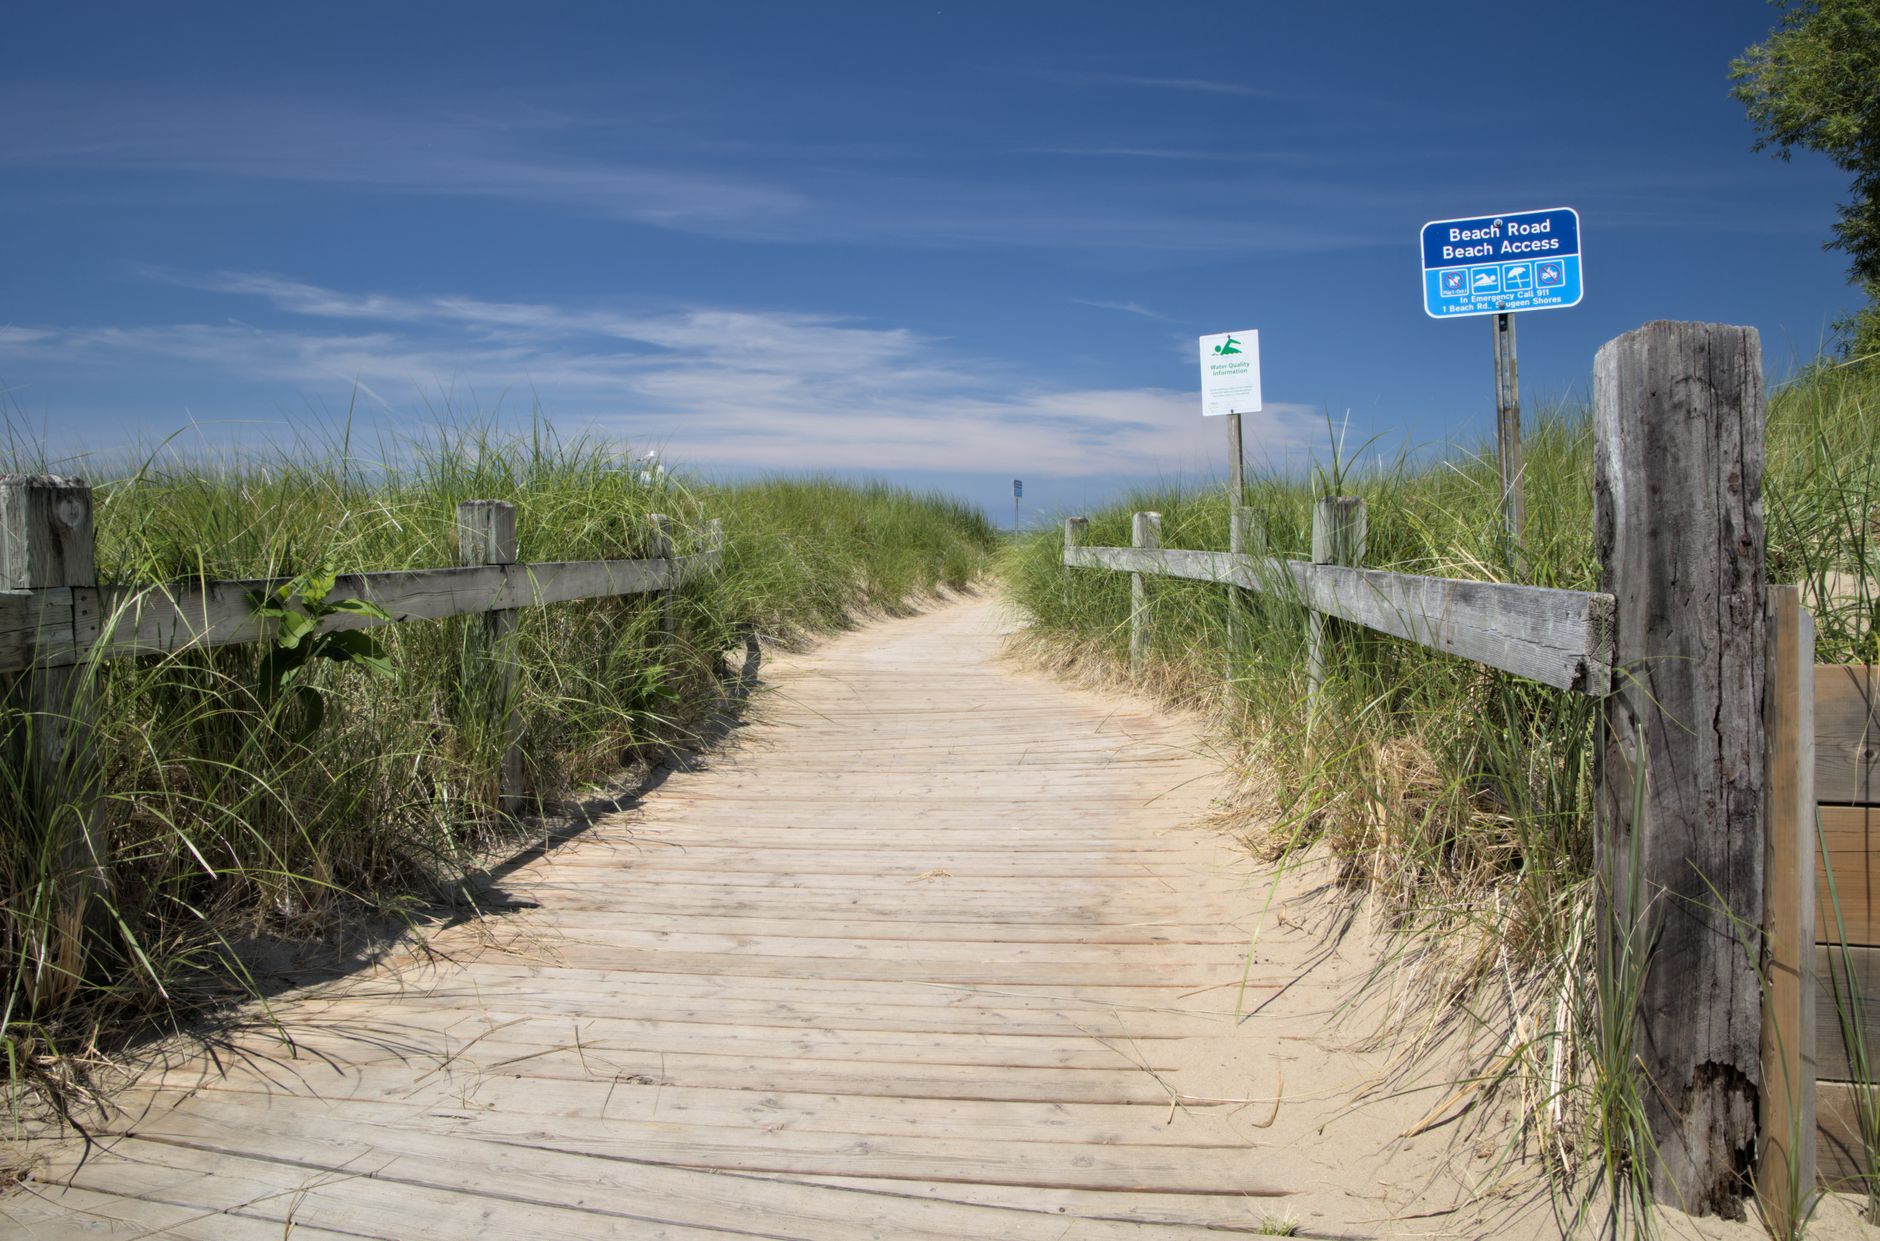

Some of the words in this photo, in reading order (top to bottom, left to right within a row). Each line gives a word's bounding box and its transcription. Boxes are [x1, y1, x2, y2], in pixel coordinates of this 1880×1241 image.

[1450, 225, 1500, 242] Beach
[1508, 219, 1550, 236] Road
[1442, 242, 1493, 259] Beach
[1500, 238, 1559, 254] Access
[1450, 304, 1474, 313] Beach
[1496, 299, 1530, 309] Sugeen
[1533, 296, 1562, 304] Shores
[1471, 292, 1514, 304] Emergency
[1518, 290, 1534, 299] Call
[1537, 288, 1550, 296] 911
